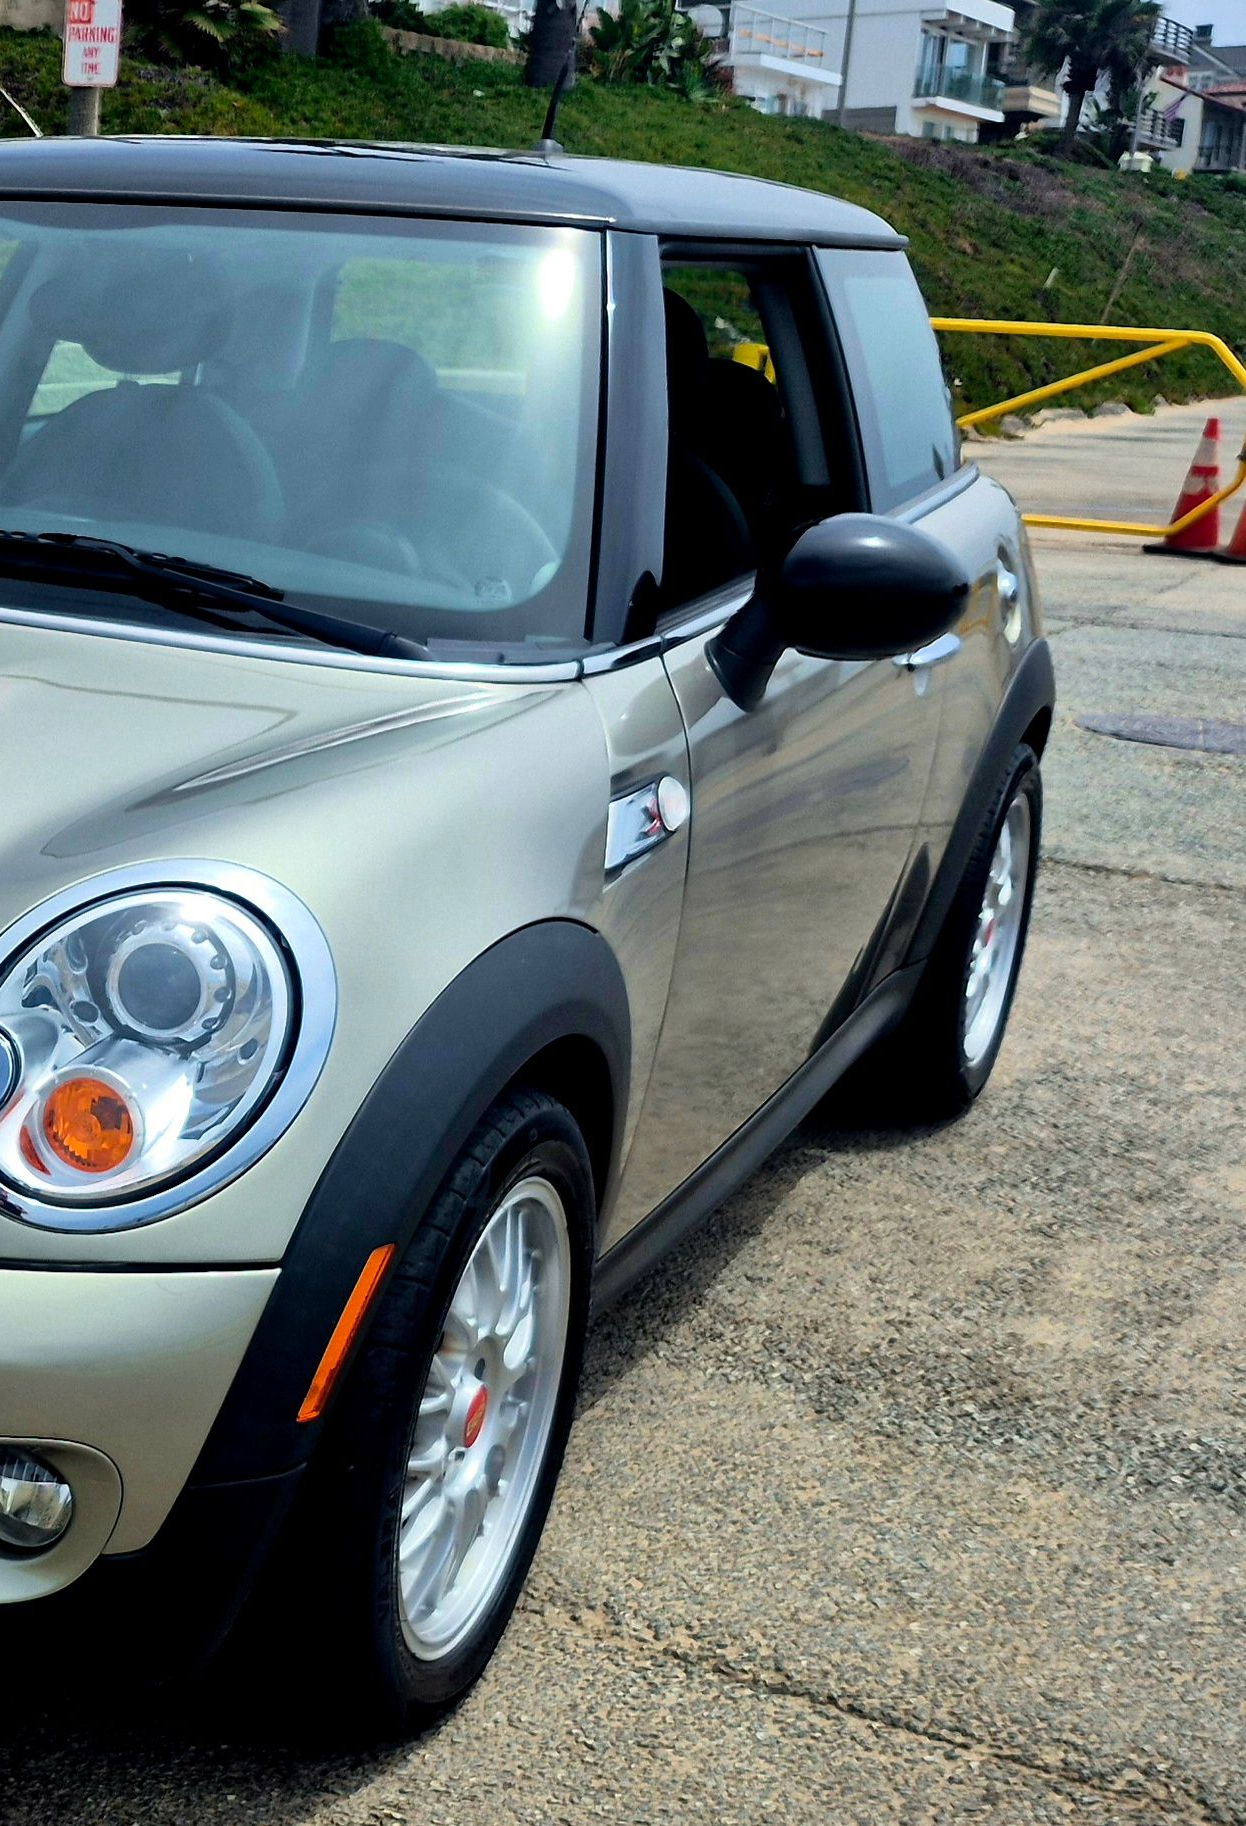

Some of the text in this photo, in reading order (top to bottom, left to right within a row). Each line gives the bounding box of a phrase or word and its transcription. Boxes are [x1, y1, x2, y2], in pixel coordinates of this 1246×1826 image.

[70, 2, 90, 21] NO
[68, 26, 115, 43] PARKING
[82, 47, 101, 58] ANY
[81, 62, 101, 75] TIME
